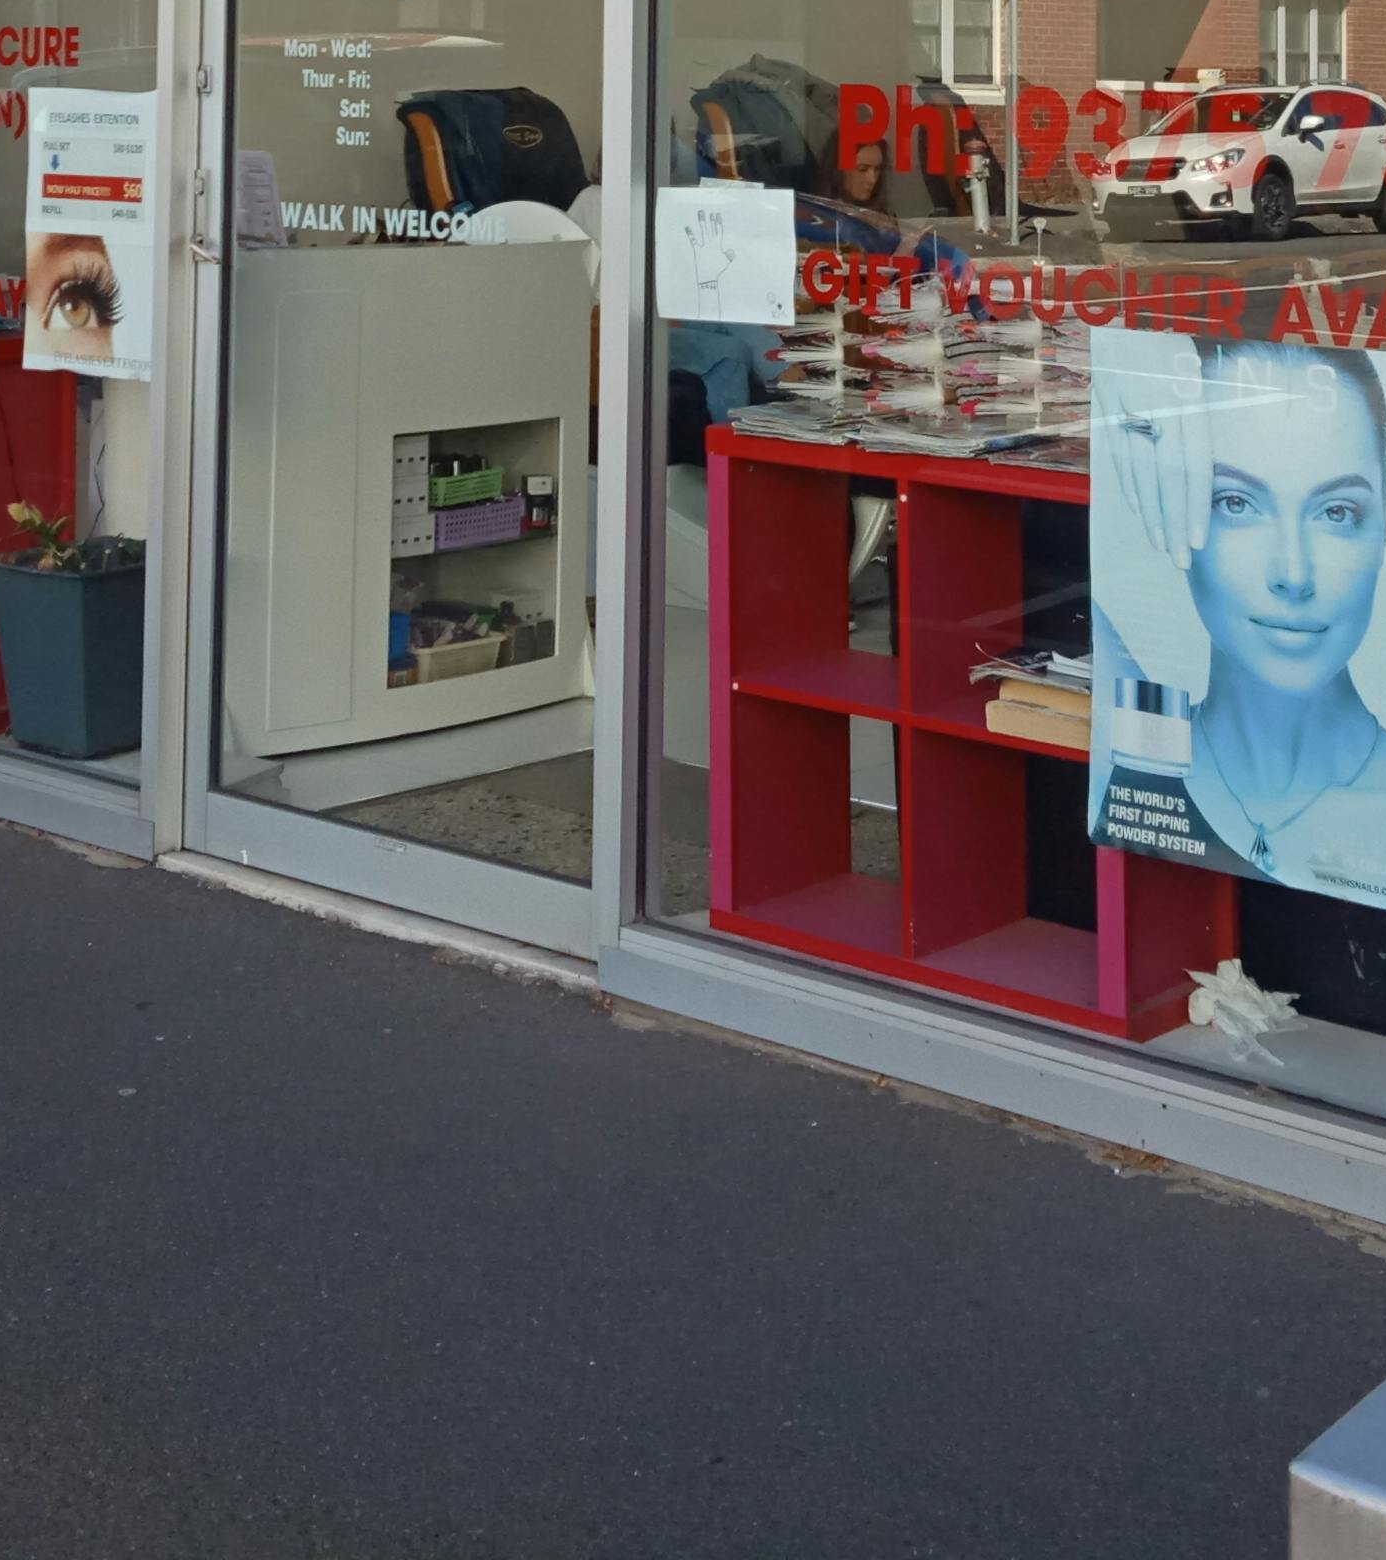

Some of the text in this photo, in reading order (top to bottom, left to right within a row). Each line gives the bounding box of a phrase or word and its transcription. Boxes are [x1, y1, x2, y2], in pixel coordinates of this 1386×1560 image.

[284, 39, 318, 58] Mon
[331, 38, 372, 58] Wed:
[301, 68, 335, 88] Thur
[348, 69, 371, 89] Fri:
[340, 98, 370, 118] Sat:
[335, 126, 370, 146] Sun:
[837, 83, 973, 177] Ph:
[1015, 81, 1269, 184] 9375
[280, 201, 508, 245] WALK IN WELCOME
[800, 249, 917, 311] GIFT
[938, 255, 1247, 337] VOUCHER
[1109, 784, 1186, 813] THE WORLD'S
[1108, 803, 1190, 834] FIRST DIPPING
[1107, 822, 1206, 856] POWDER SYSTEM
